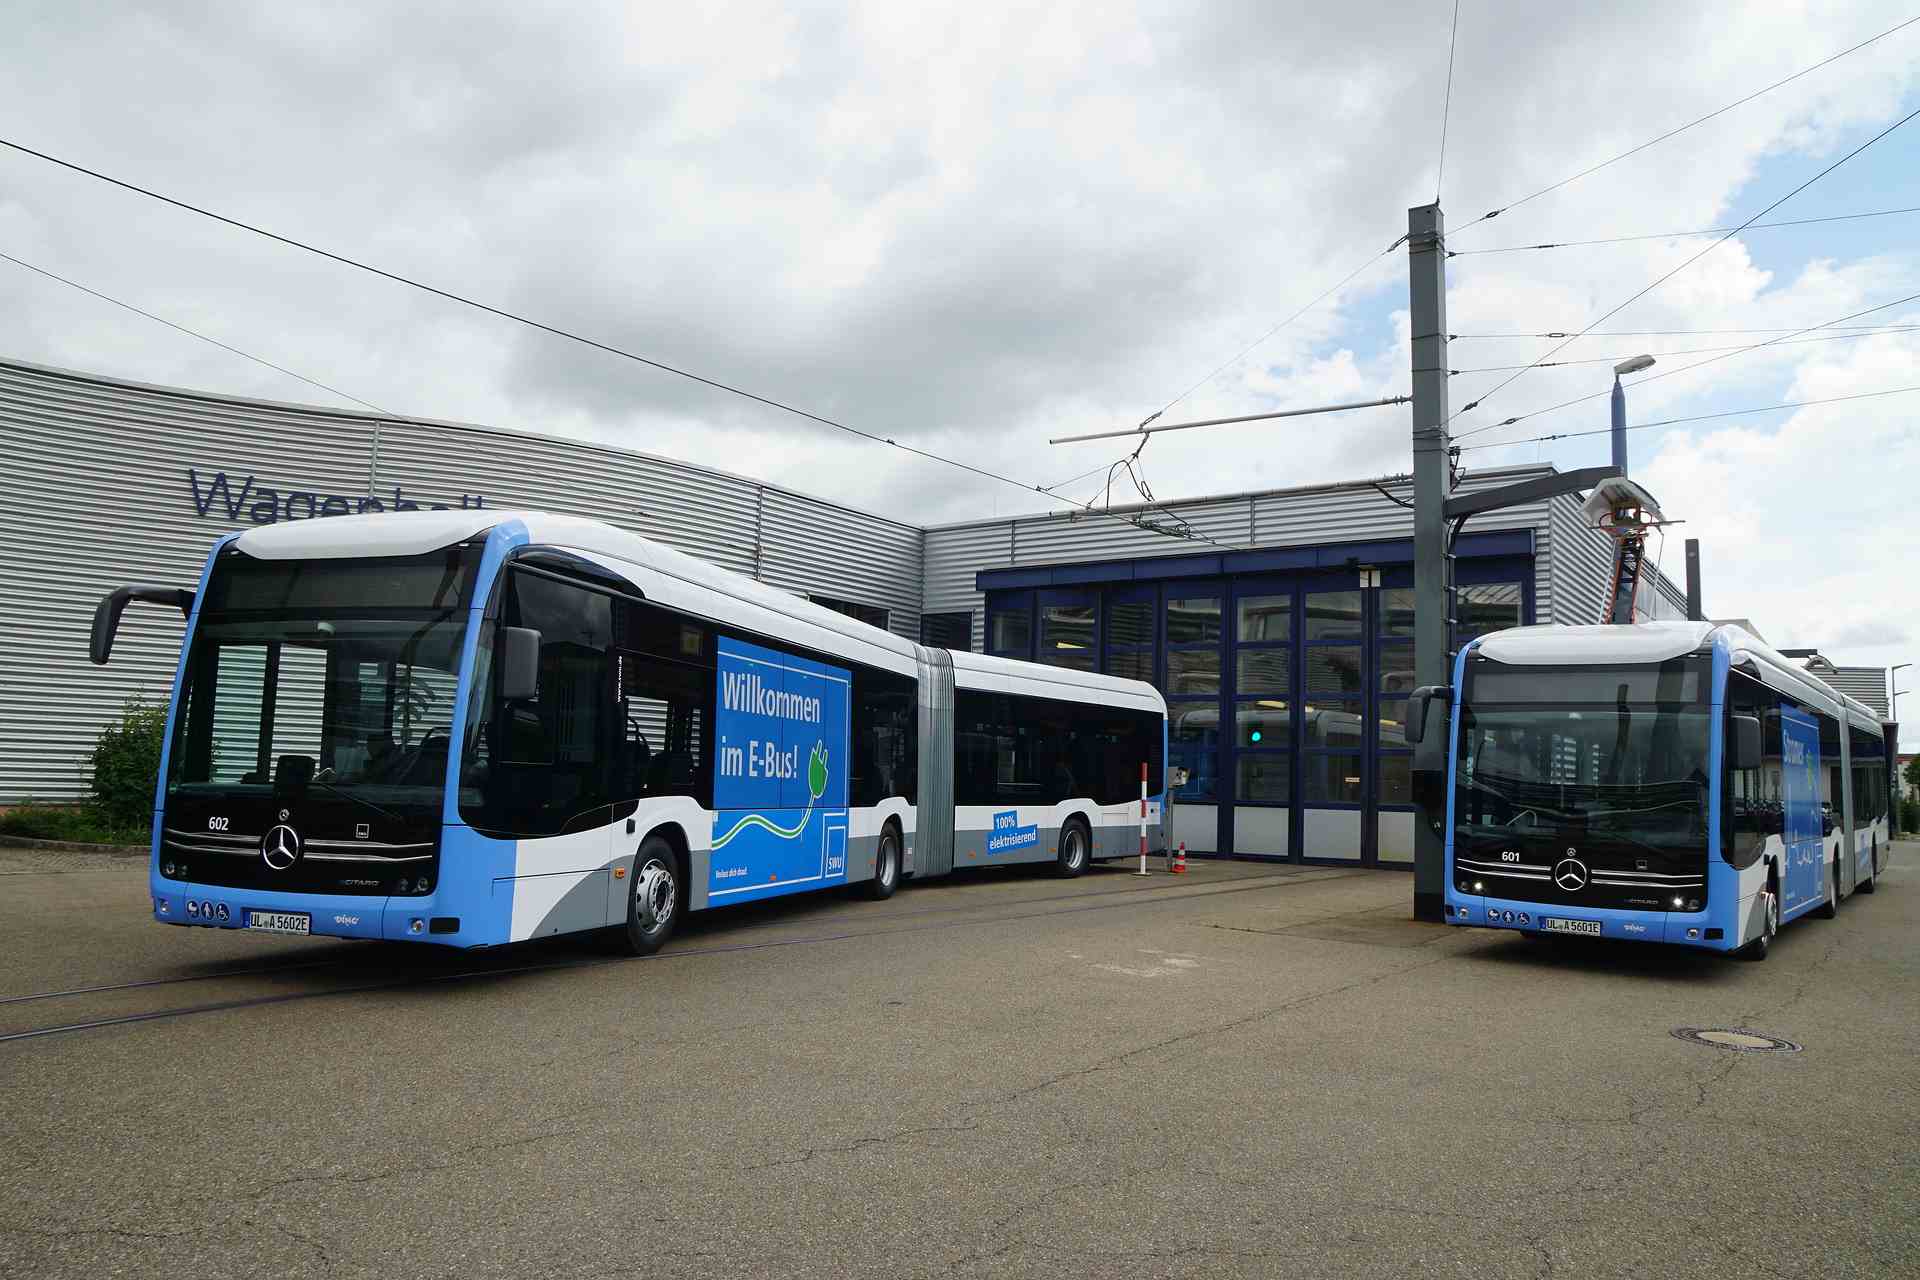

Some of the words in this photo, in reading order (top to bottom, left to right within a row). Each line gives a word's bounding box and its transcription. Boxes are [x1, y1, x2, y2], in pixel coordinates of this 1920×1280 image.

[722, 671, 820, 723] Willkommen
[720, 735, 743, 776] im
[748, 740, 798, 779] E-Bus!
[208, 816, 229, 831] 602
[995, 815, 1016, 829] 100%
[990, 827, 1036, 850] elektrisierend
[828, 856, 842, 870] SWU
[1501, 851, 1520, 862] 601
